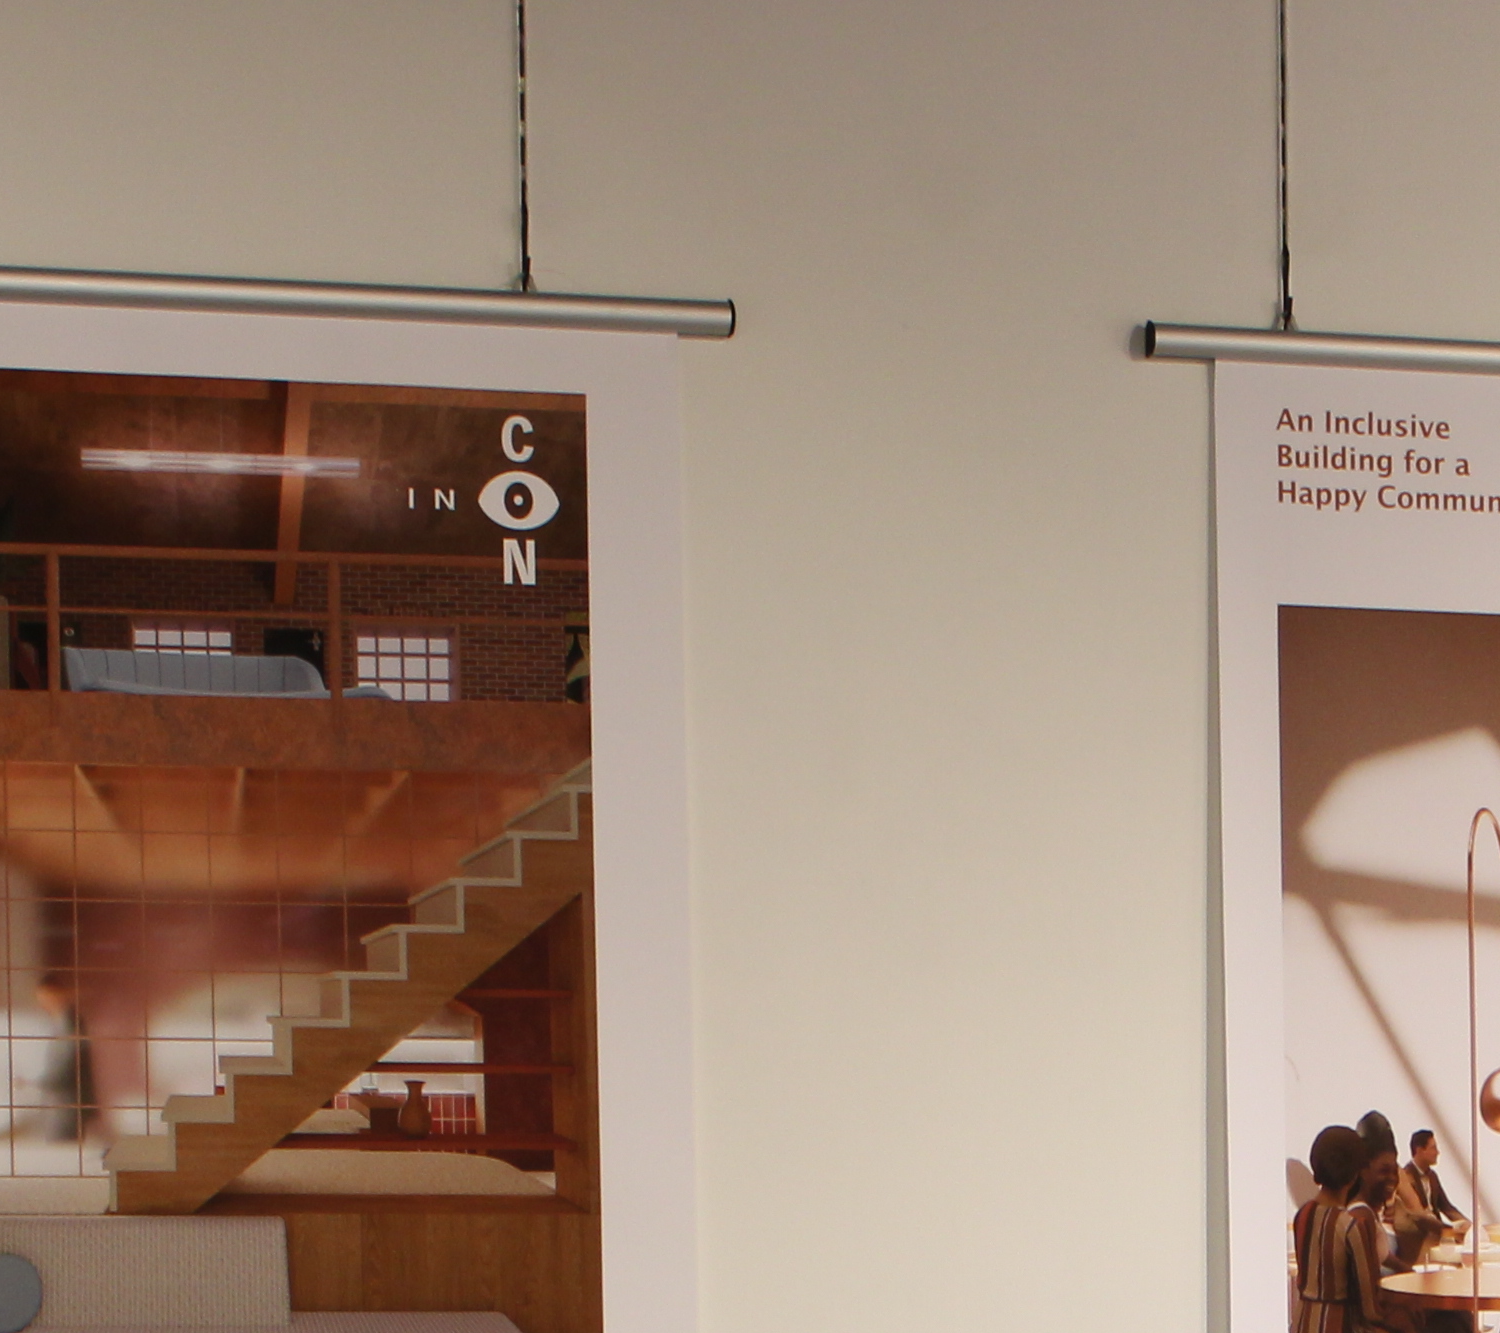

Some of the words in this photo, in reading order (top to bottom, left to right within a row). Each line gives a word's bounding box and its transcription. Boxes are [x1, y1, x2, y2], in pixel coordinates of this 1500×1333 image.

[1276, 408, 1314, 433] An
[1325, 410, 1451, 440] Inclusive
[1277, 444, 1394, 478] Building
[1404, 449, 1446, 475] for
[1455, 457, 1472, 477] a
[1277, 480, 1368, 512] Happy
